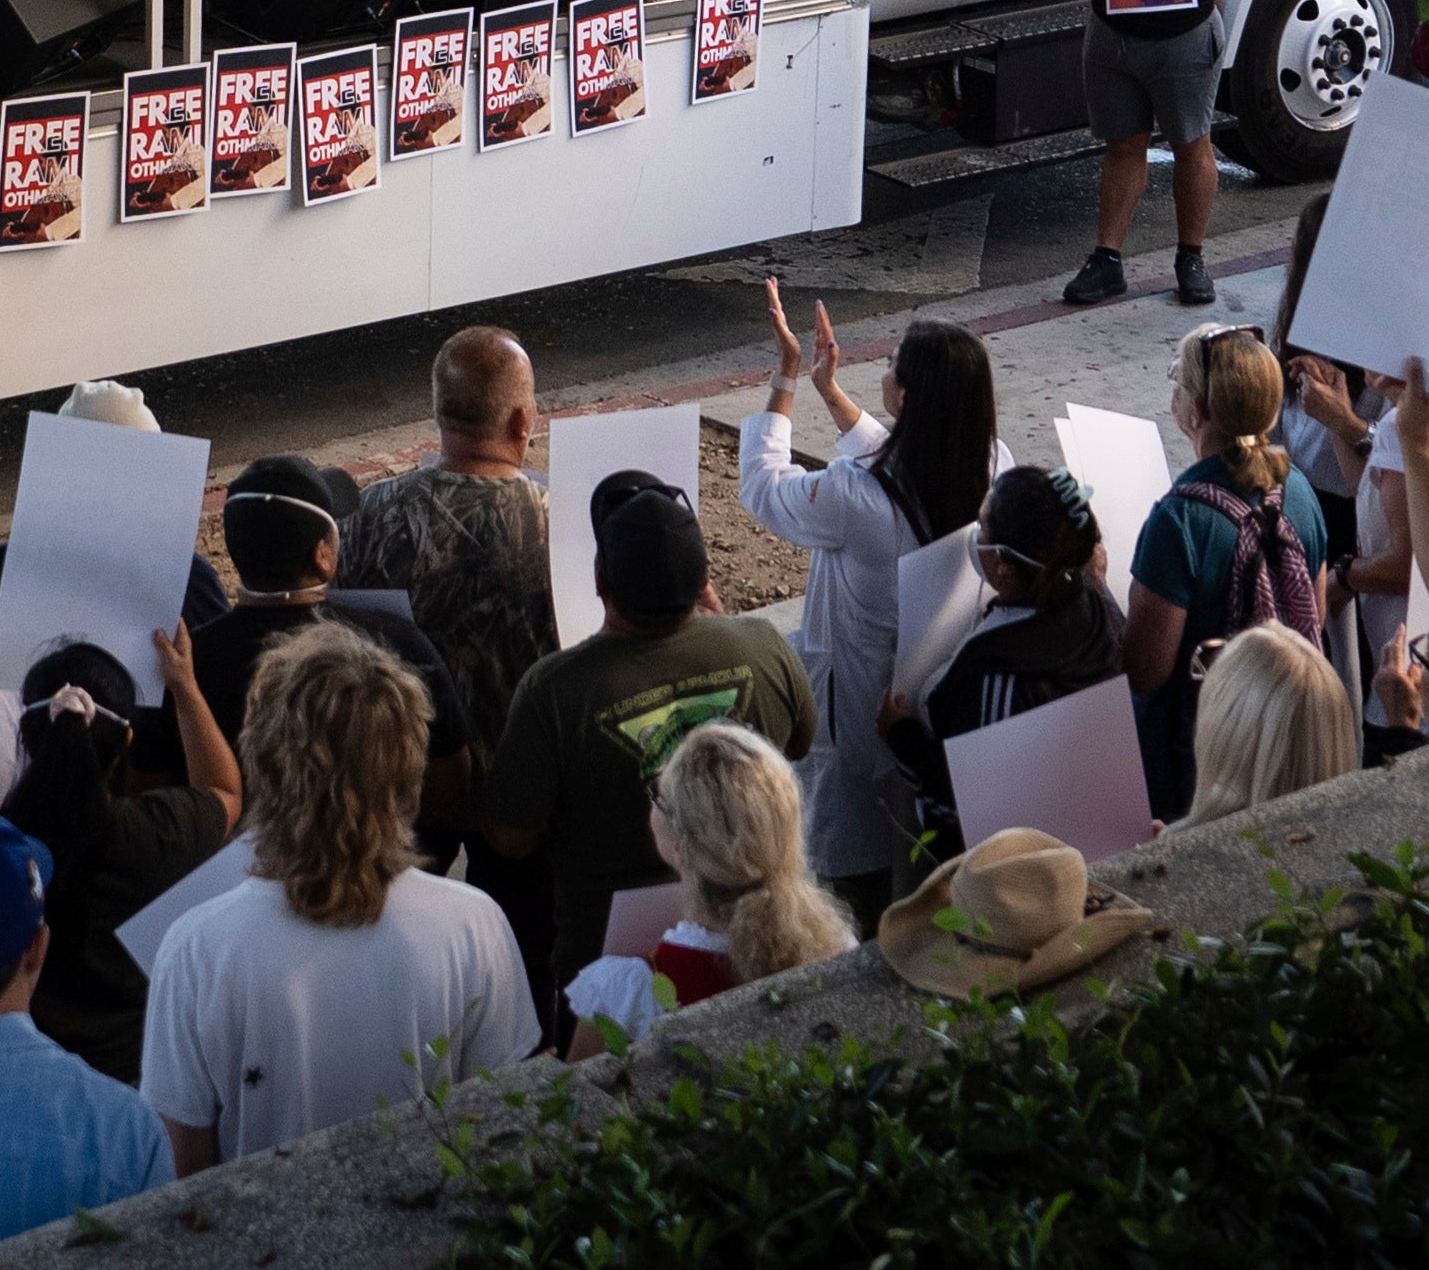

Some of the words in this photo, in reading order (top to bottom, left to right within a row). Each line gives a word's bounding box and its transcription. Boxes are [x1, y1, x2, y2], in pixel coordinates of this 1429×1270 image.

[487, 23, 550, 64] FREE
[576, 7, 638, 51] FREE
[701, 14, 756, 48] RAMI
[400, 32, 464, 71] FREE
[577, 41, 639, 80] RAMI
[219, 68, 287, 107] FREE
[306, 71, 370, 113] FREE
[399, 66, 461, 102] RAMI
[487, 56, 548, 95] RAMI
[131, 89, 203, 129] FREE
[217, 103, 285, 138] RAMI
[307, 105, 371, 145] RAMI
[7, 117, 80, 157] FREE
[130, 125, 202, 161] RAMI
[4, 153, 79, 190] RAMI
